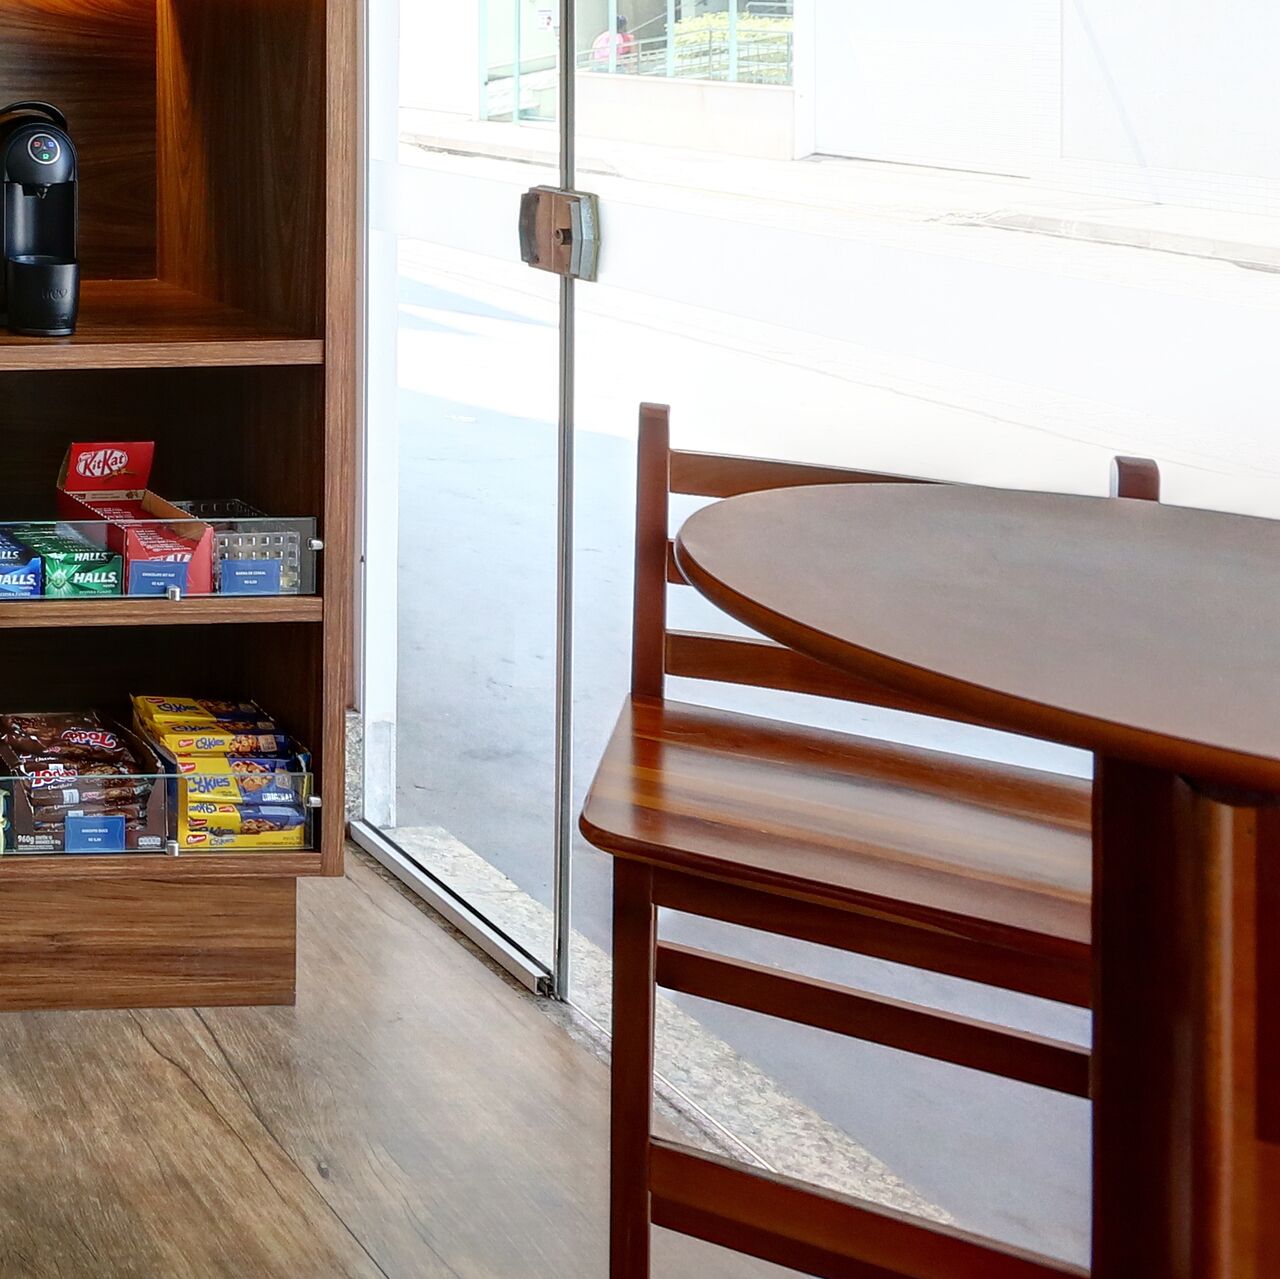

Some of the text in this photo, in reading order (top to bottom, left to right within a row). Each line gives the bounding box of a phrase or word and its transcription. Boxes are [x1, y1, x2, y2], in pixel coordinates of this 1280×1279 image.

[81, 449, 125, 477] KitKat
[74, 552, 108, 562] HALLS
[73, 571, 118, 584] HALLS
[195, 736, 226, 750] Cookies
[17, 834, 35, 845] 960g
